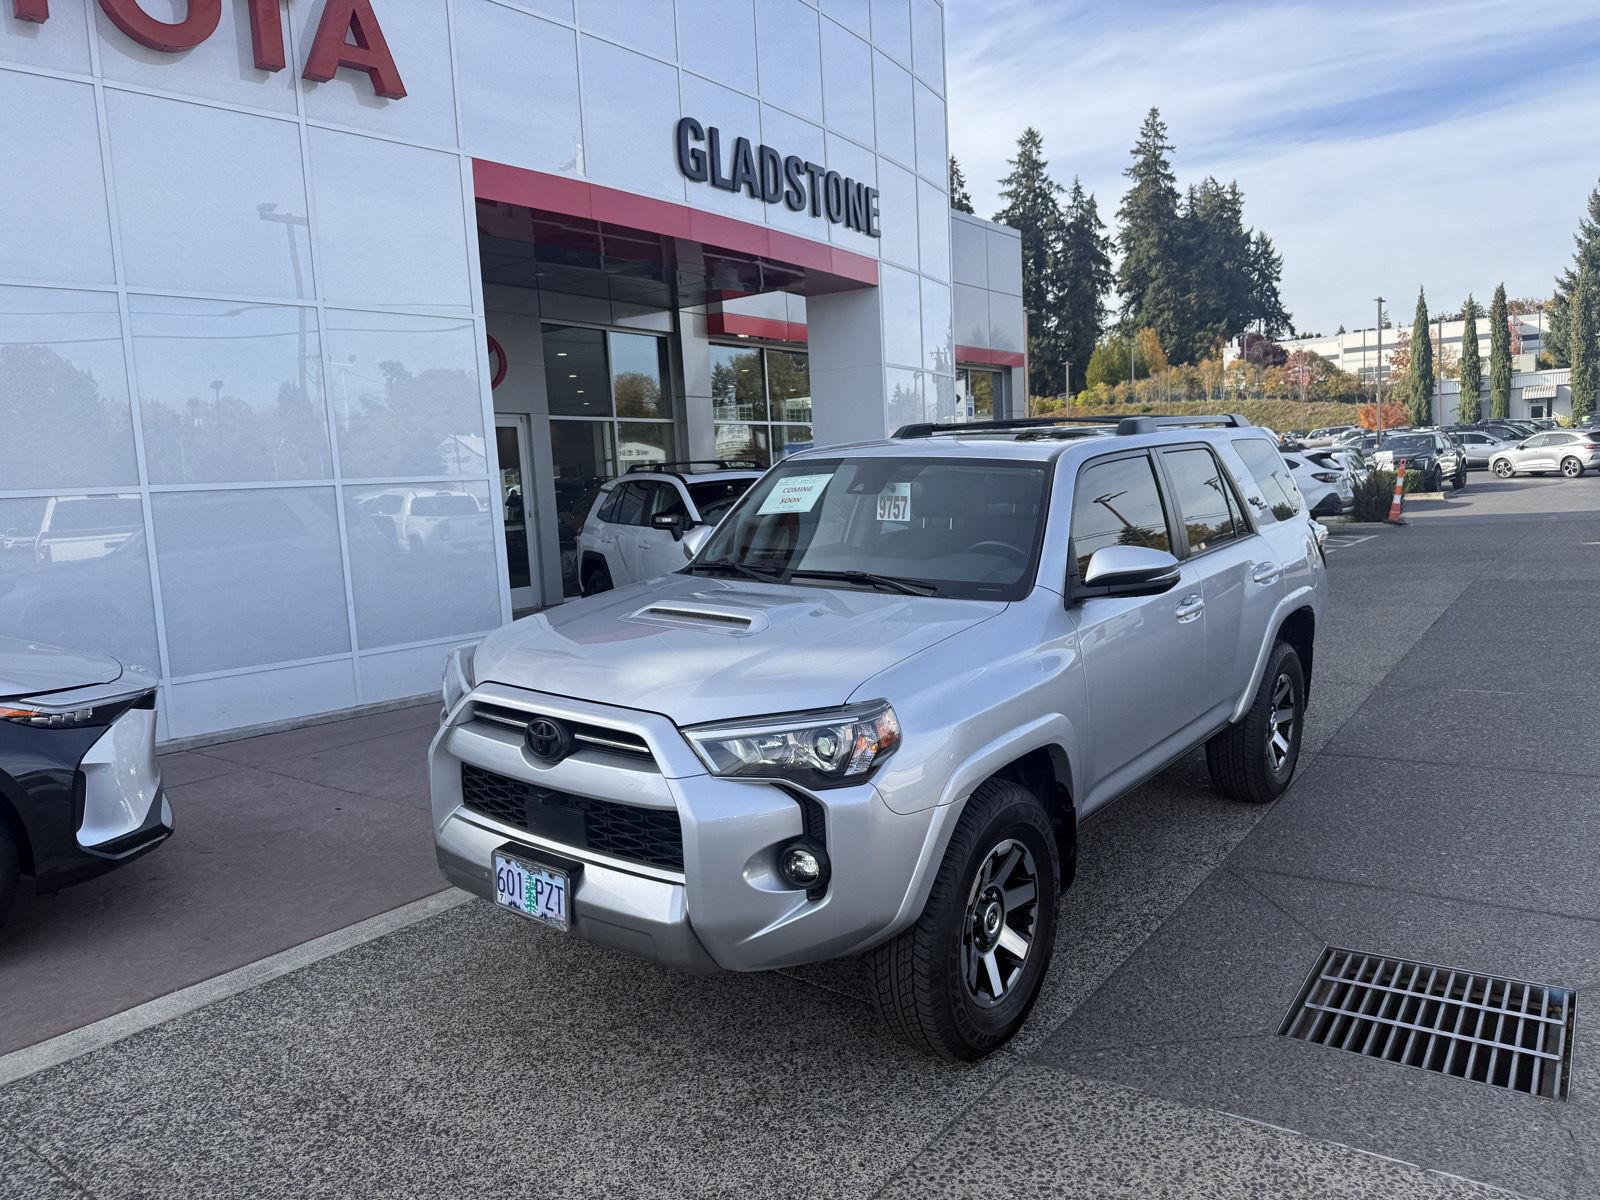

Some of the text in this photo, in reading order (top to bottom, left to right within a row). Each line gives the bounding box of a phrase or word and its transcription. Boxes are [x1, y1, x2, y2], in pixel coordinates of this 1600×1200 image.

[676, 116, 881, 238] GLADSTONE
[779, 497, 802, 505] SOON
[782, 485, 813, 494] COMING
[878, 495, 908, 520] 9757
[497, 866, 522, 900] 601
[535, 877, 564, 914] PZT
